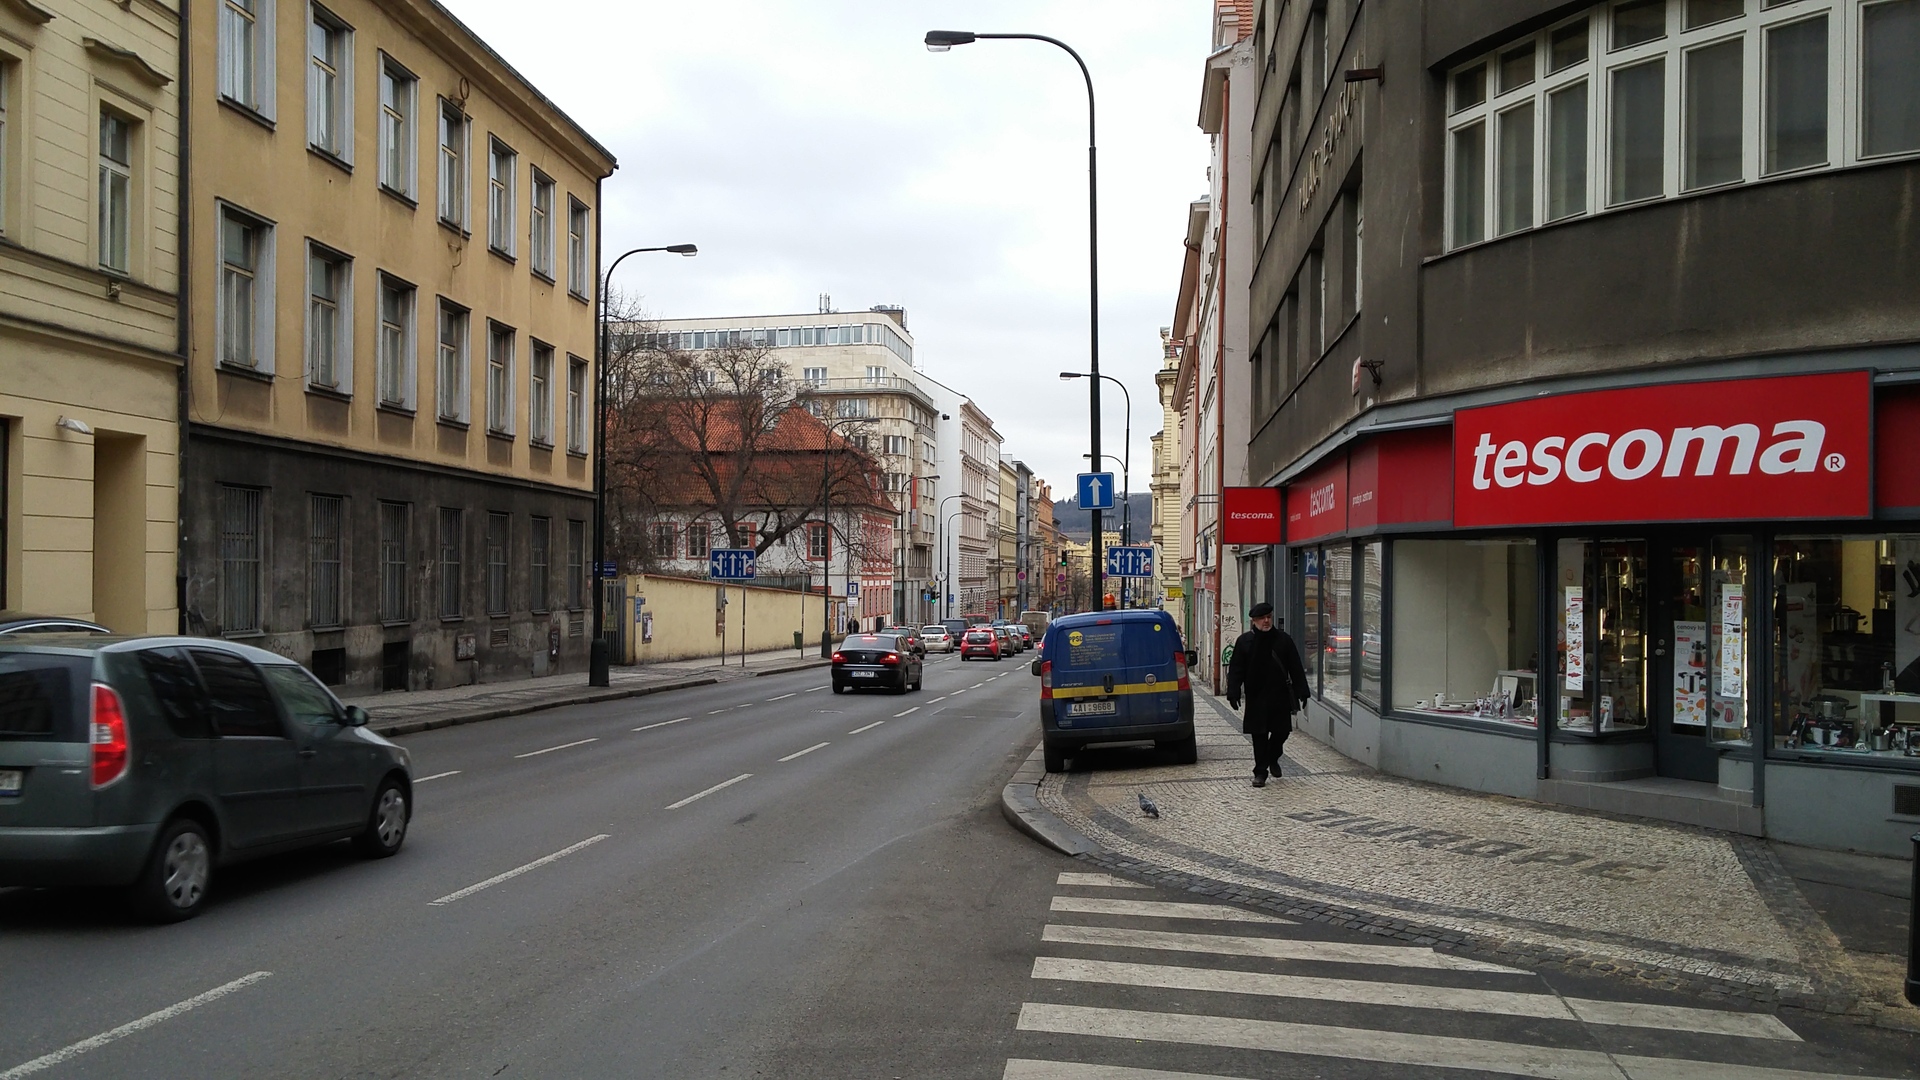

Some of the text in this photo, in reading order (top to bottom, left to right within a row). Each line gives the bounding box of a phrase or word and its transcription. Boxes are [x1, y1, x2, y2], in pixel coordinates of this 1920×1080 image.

[1472, 420, 1826, 490] tescoma
[1230, 511, 1274, 520] tescoma
[1309, 482, 1335, 518] tescoma
